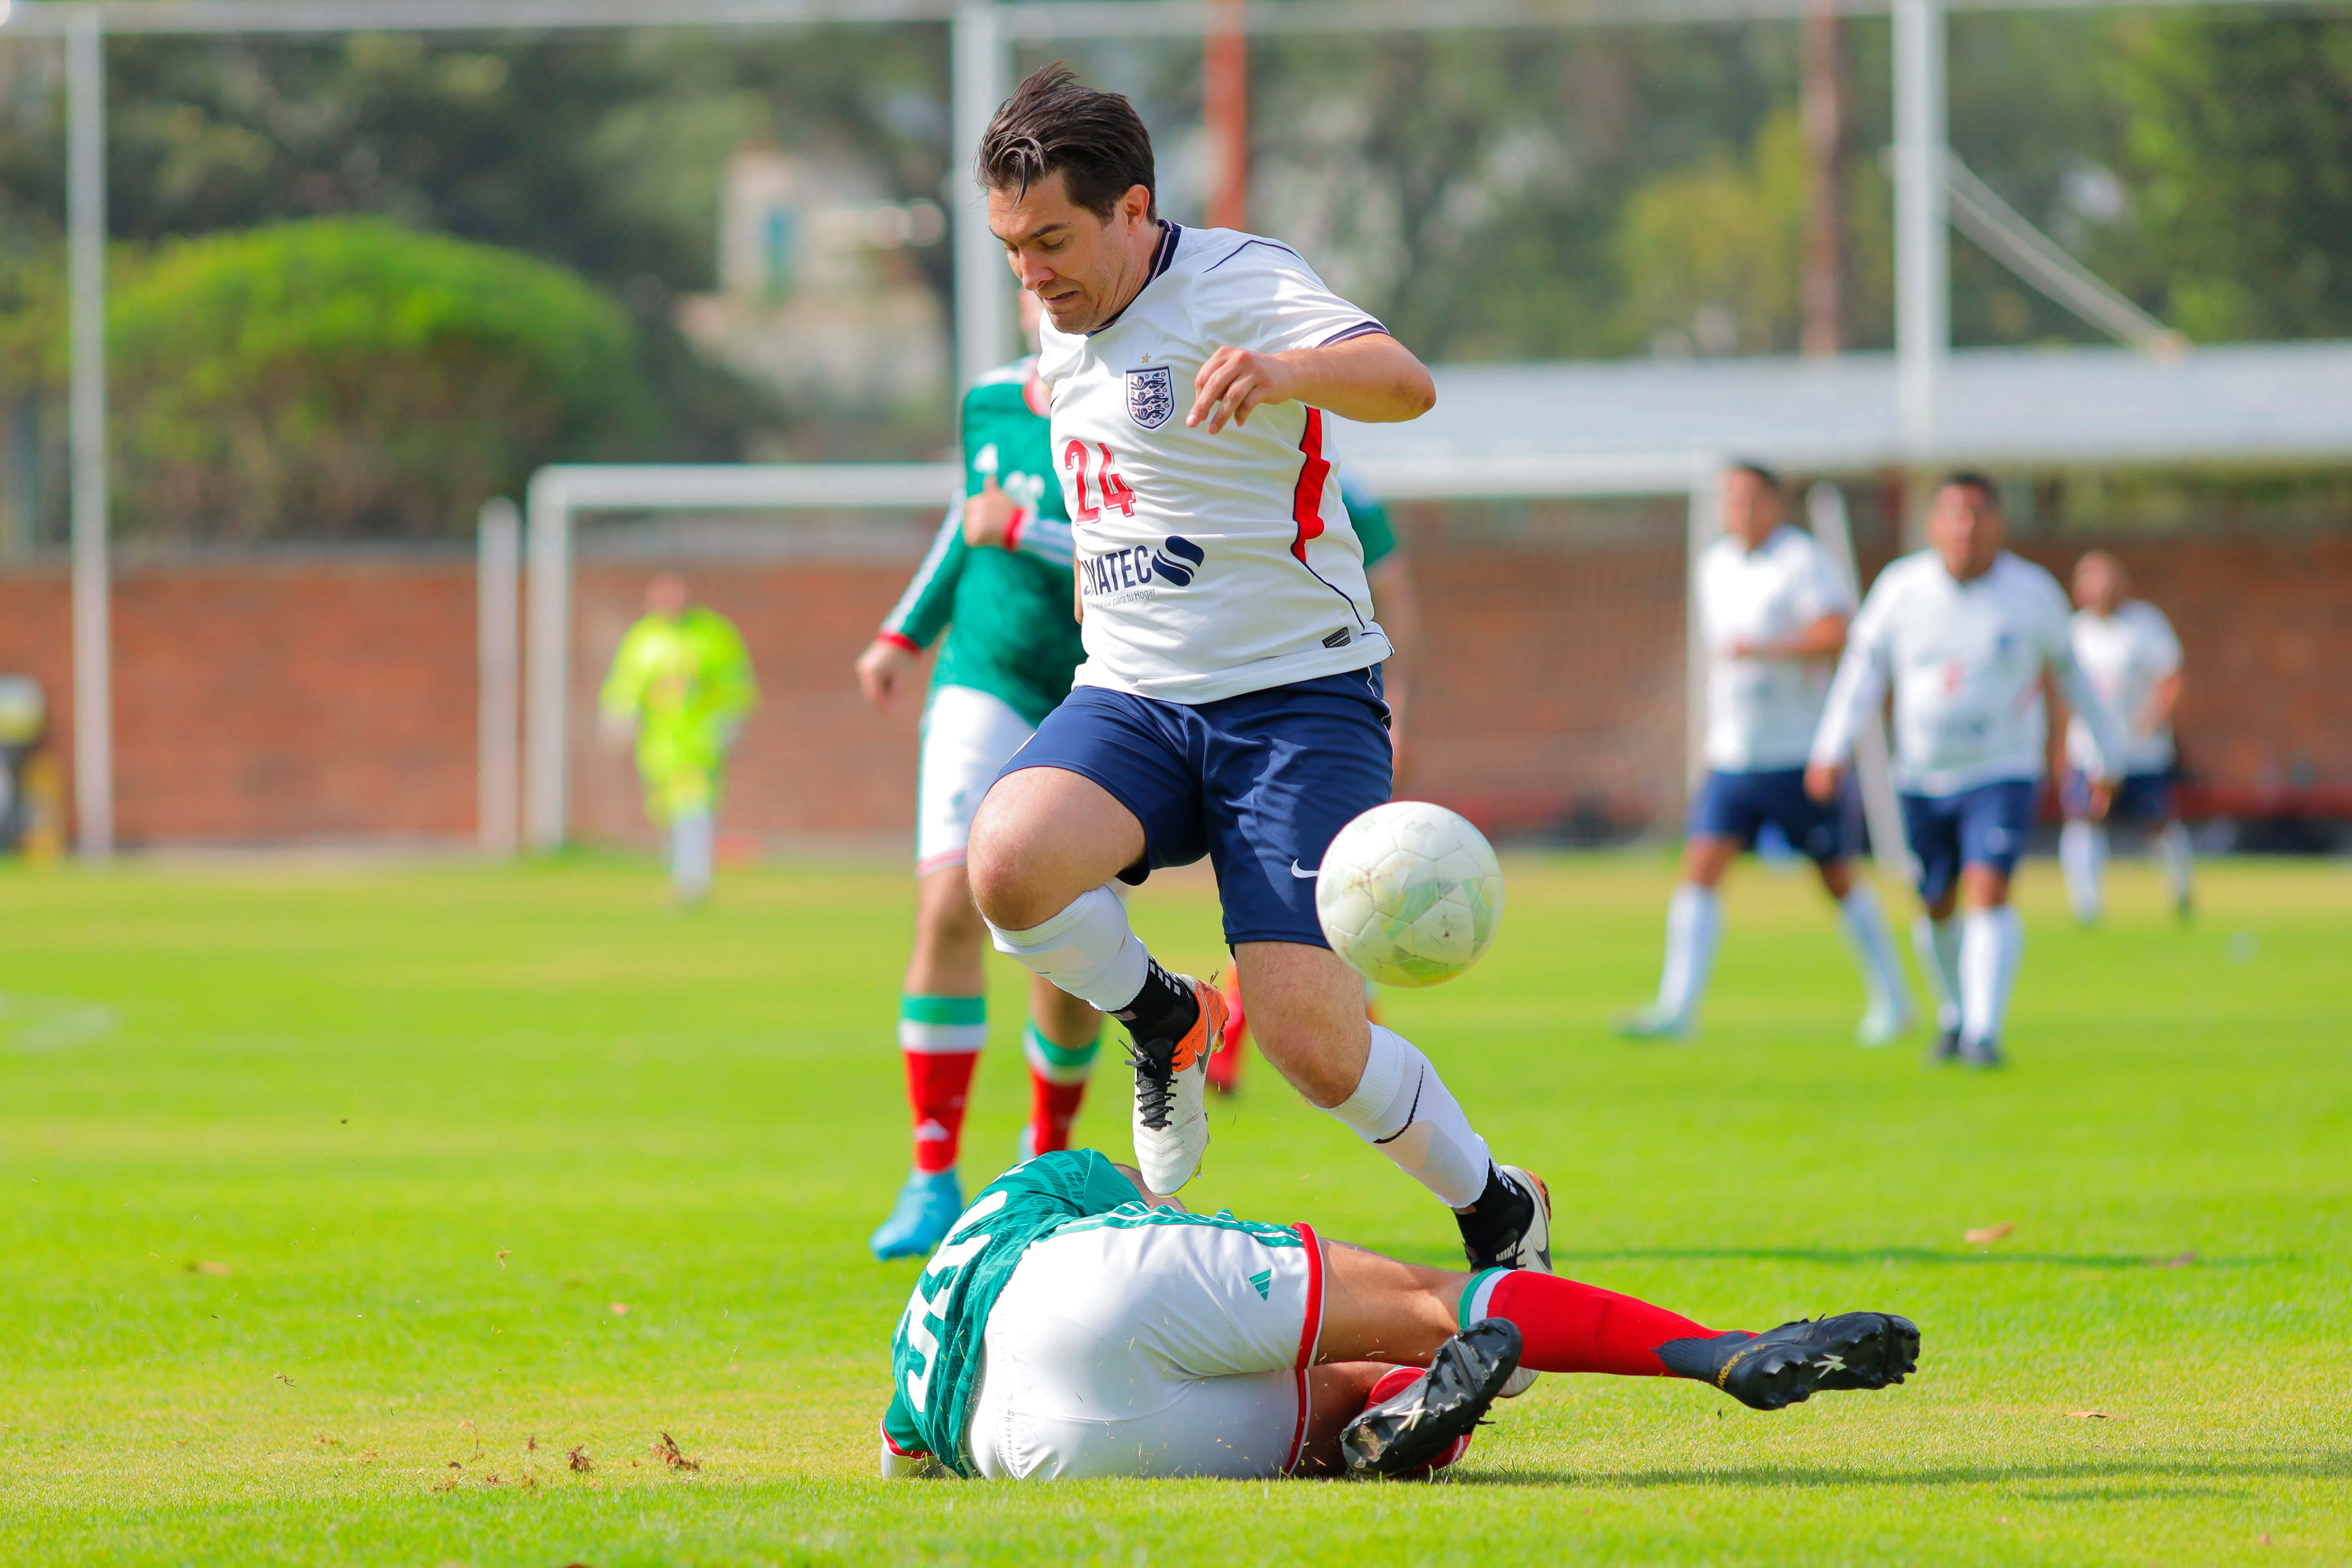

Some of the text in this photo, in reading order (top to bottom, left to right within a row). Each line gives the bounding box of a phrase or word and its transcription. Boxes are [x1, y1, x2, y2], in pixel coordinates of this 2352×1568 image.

[1064, 440, 1135, 526] 24
[1113, 595, 1126, 609] para
[1127, 593, 1133, 602] tu
[1133, 588, 1156, 600] Hogar
